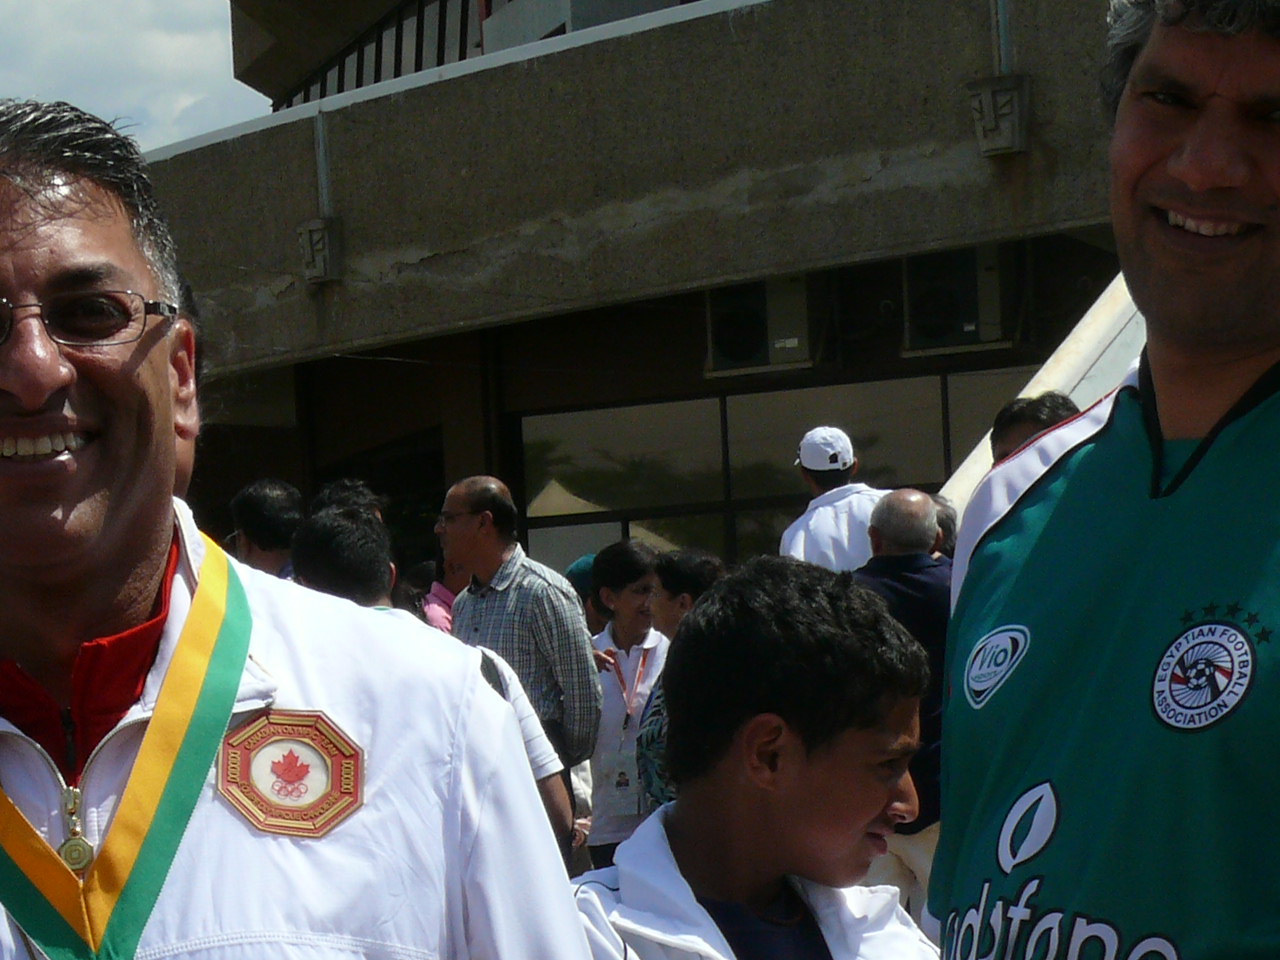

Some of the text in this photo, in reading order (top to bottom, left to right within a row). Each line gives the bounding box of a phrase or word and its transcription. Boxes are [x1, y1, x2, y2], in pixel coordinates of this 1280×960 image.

[1157, 626, 1250, 698] EGYPTIAN FOOTBALL
[1155, 690, 1229, 726] ASSOCIATION
